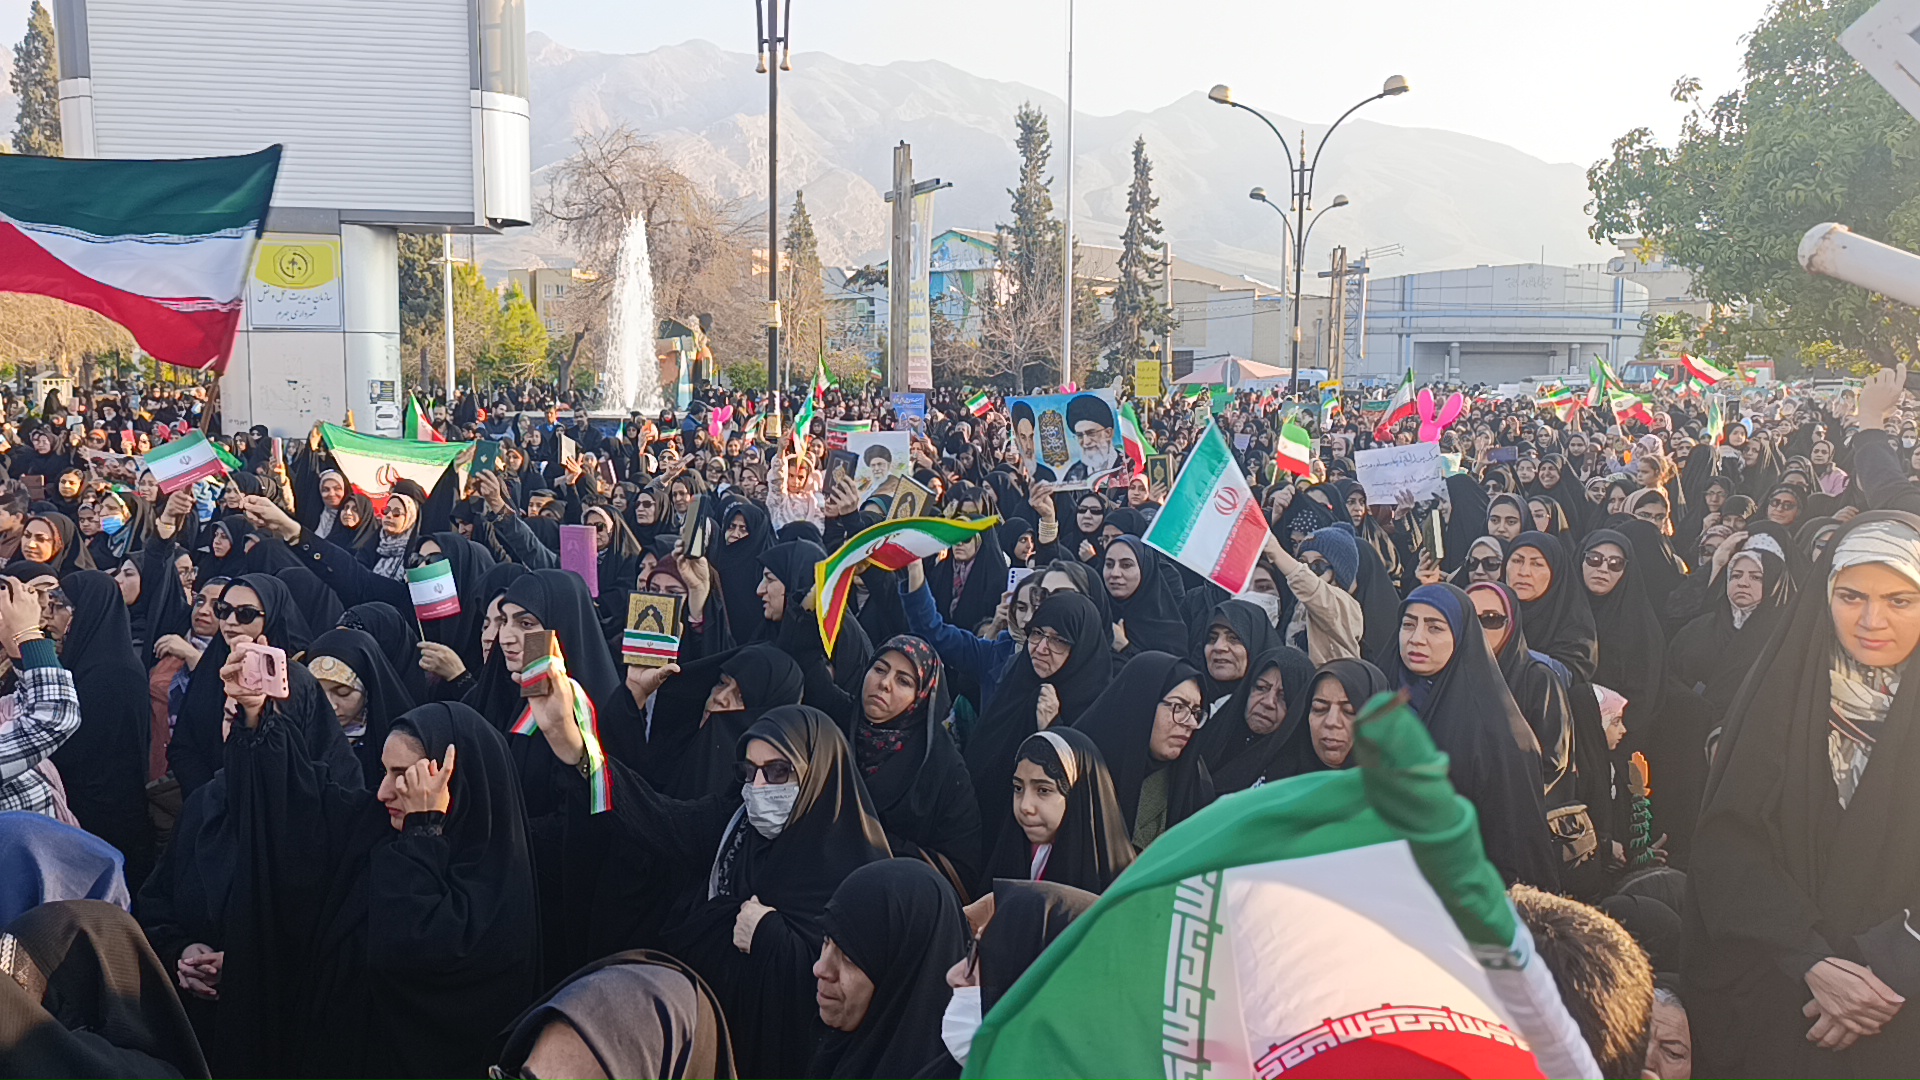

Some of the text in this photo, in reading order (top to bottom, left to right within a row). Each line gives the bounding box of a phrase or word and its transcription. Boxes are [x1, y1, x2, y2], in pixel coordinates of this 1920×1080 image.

[257, 284, 270, 303] نقل
[275, 290, 287, 303] حمل
[288, 293, 311, 305] مدیریت
[312, 292, 333, 304] سازمان
[276, 305, 318, 321] شهرداری جهرم
